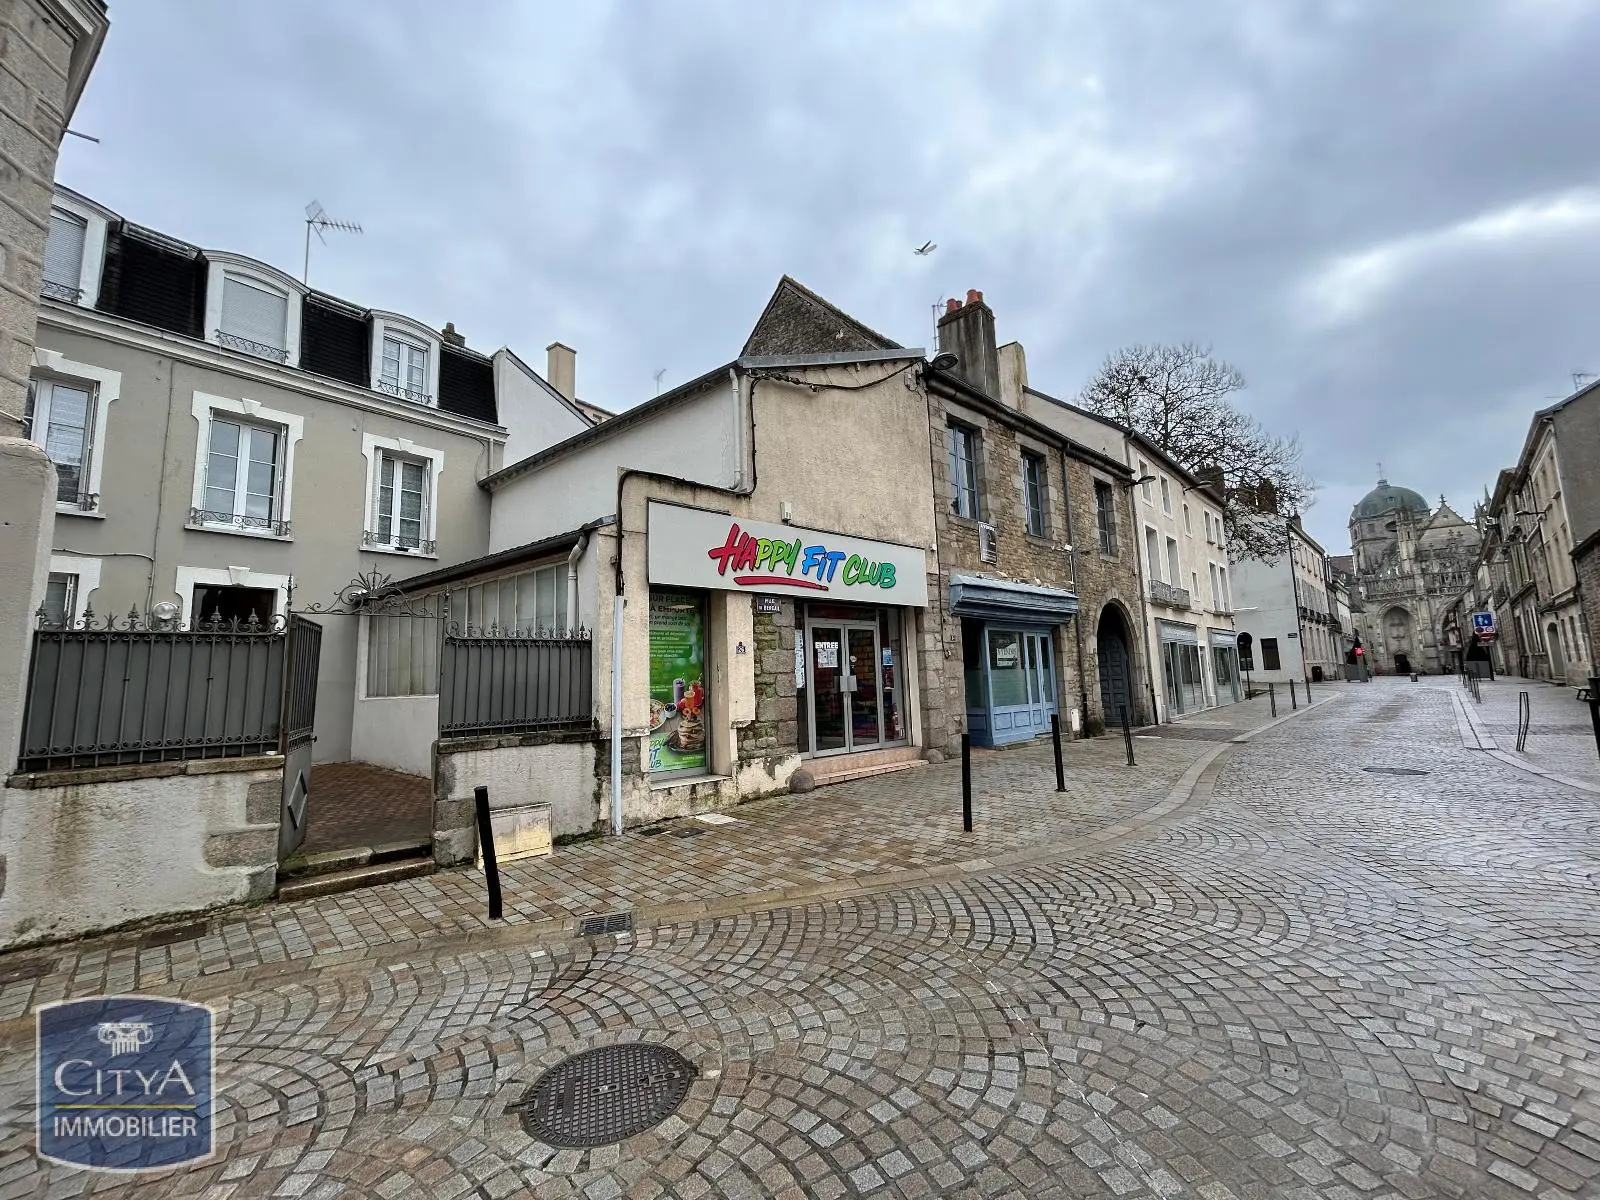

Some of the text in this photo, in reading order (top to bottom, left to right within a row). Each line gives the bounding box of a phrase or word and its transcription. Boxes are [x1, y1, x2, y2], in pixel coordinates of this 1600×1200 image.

[708, 523, 897, 589] HAPPY FIT CLUB
[815, 641, 839, 649] ENTREE
